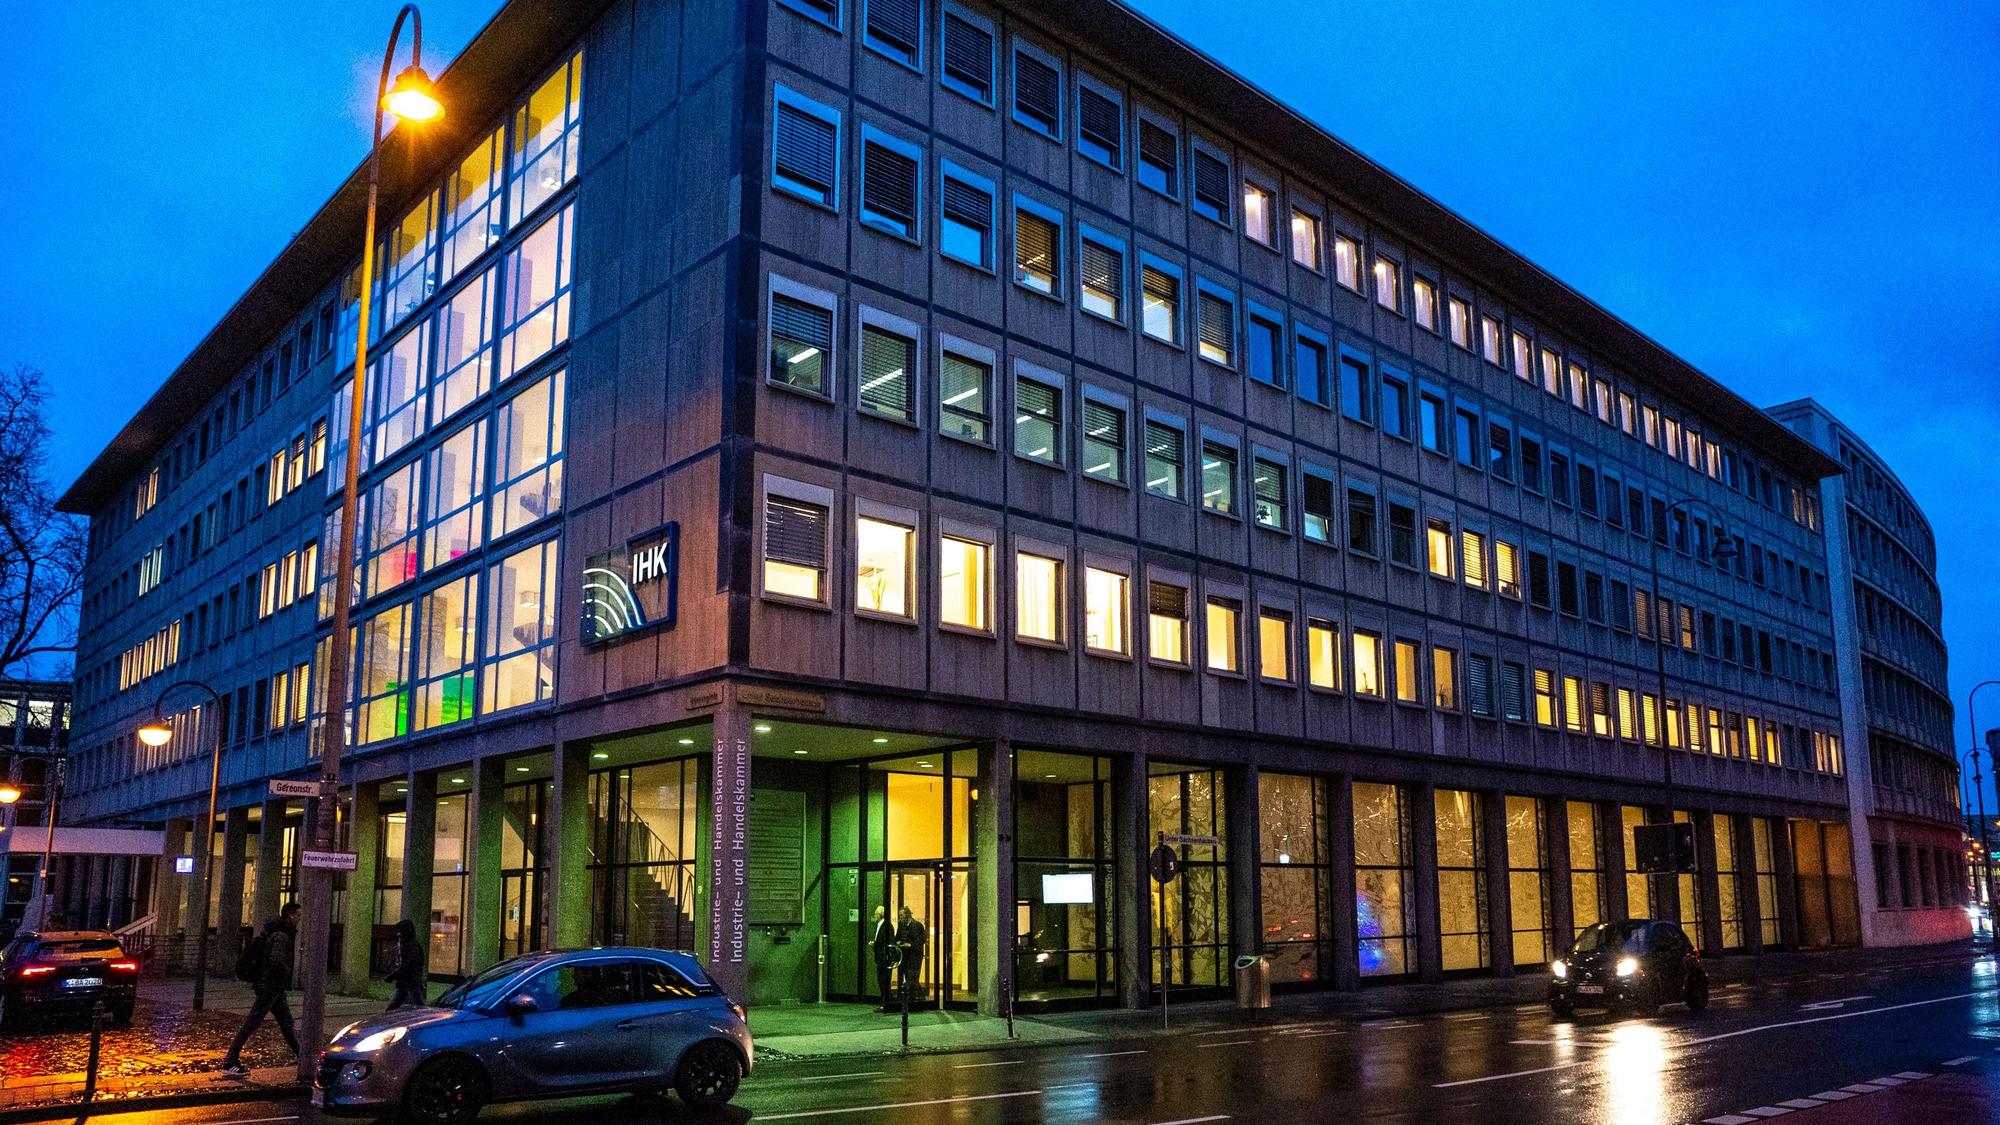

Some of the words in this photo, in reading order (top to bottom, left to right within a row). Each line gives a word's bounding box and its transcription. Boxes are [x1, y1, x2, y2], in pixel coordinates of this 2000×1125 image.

[632, 542, 668, 585] IHK
[276, 782, 314, 794] Gereonstr.
[714, 738, 724, 850] Handelskammer
[732, 738, 746, 850] Handelskammer
[303, 853, 355, 864] Feuerwehrzufahrt
[714, 859, 722, 886] und
[732, 859, 744, 886] und
[712, 891, 721, 963] Industrie-
[730, 891, 744, 963] Industrie-
